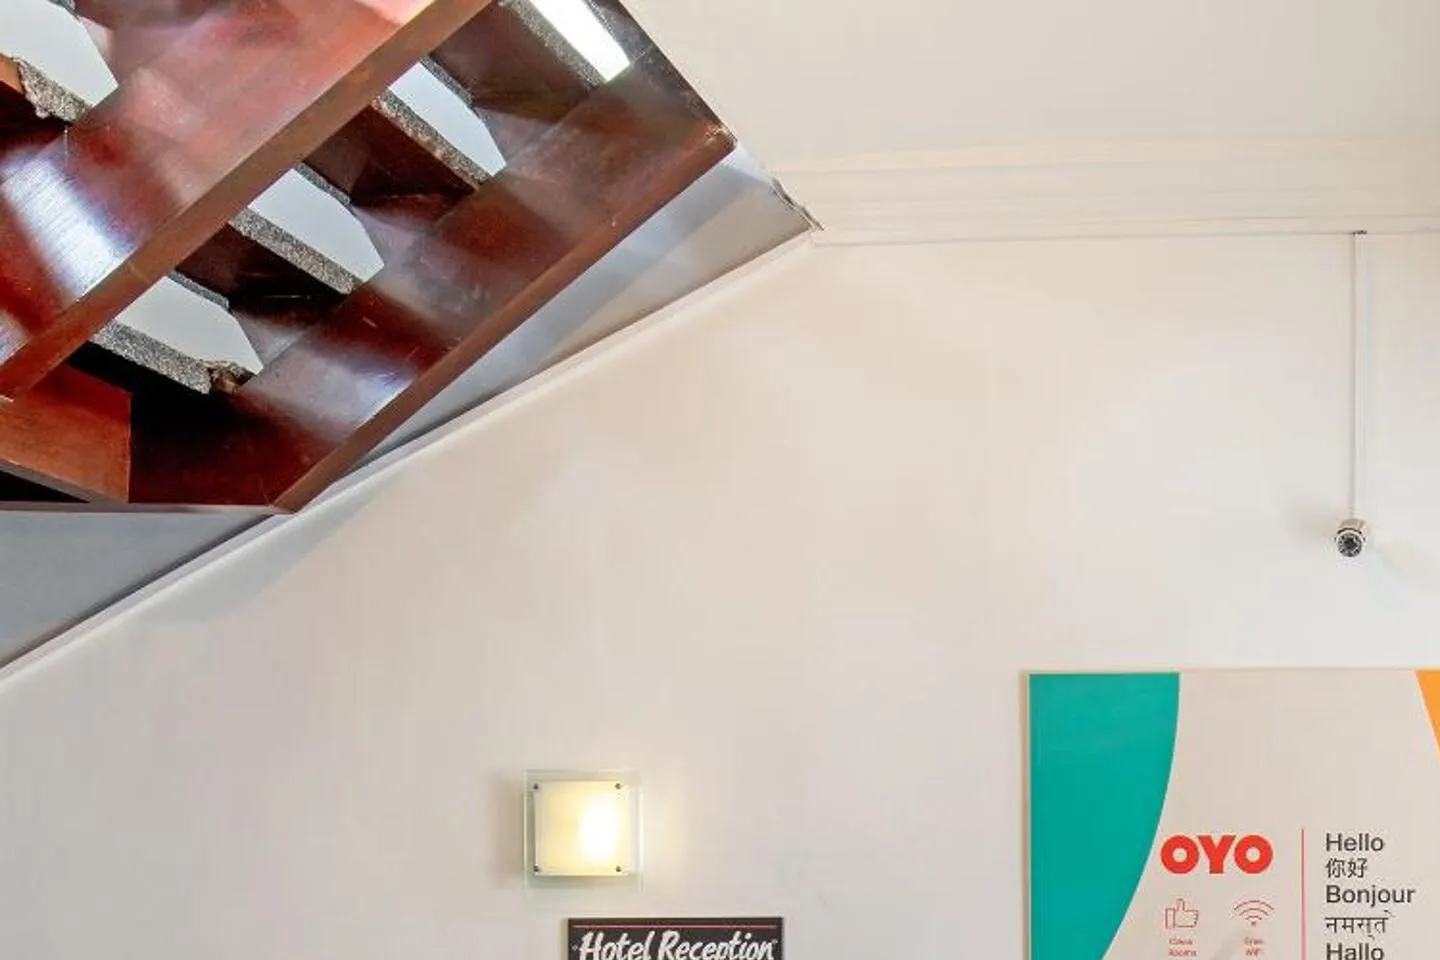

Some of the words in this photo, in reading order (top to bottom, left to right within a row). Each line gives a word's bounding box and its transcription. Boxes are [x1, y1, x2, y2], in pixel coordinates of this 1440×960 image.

[1325, 832, 1385, 852] Hello
[1160, 835, 1274, 875] OYO
[1324, 857, 1369, 879] 你好
[1325, 884, 1417, 909] Bonjour
